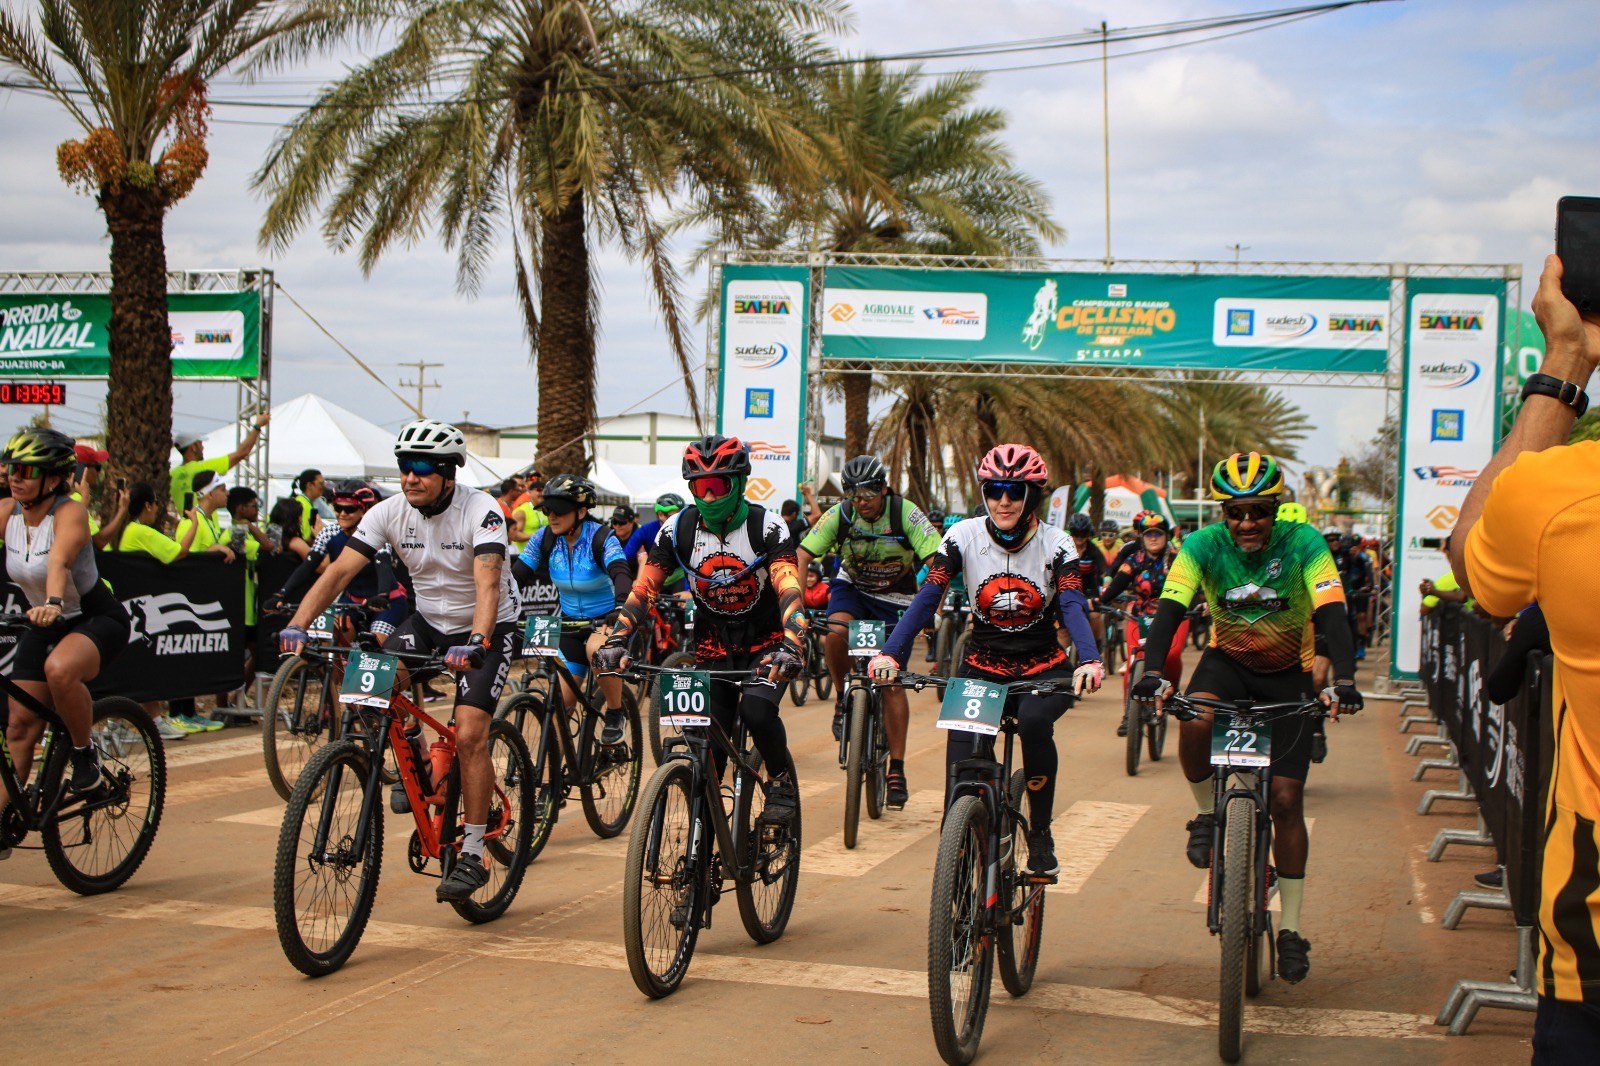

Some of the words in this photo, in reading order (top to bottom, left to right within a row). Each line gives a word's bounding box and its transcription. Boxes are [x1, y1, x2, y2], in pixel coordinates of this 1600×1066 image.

[735, 300, 790, 314] BAHIA
[863, 303, 915, 315] AGROVALE
[1073, 299, 1133, 308] CAMPEONATO
[1134, 301, 1170, 309] BAIANO
[1057, 306, 1176, 332] CICLISMO
[1266, 315, 1307, 326] sudesb
[1329, 318, 1383, 331] BAHIA
[1419, 315, 1483, 330] BAHIA
[1077, 326, 1094, 335] DE
[1096, 327, 1153, 336] ESTRADA
[735, 345, 777, 355] sudesb
[1420, 362, 1467, 374] sudesb
[521, 579, 559, 603] udesb
[156, 632, 229, 656] FAZATLETA
[530, 630, 549, 646] 41
[856, 633, 877, 648] 33
[490, 631, 515, 701] STRAVA
[360, 671, 375, 692] 9
[664, 691, 705, 712] 100
[964, 699, 982, 719] 8
[1223, 729, 1257, 752] 22
